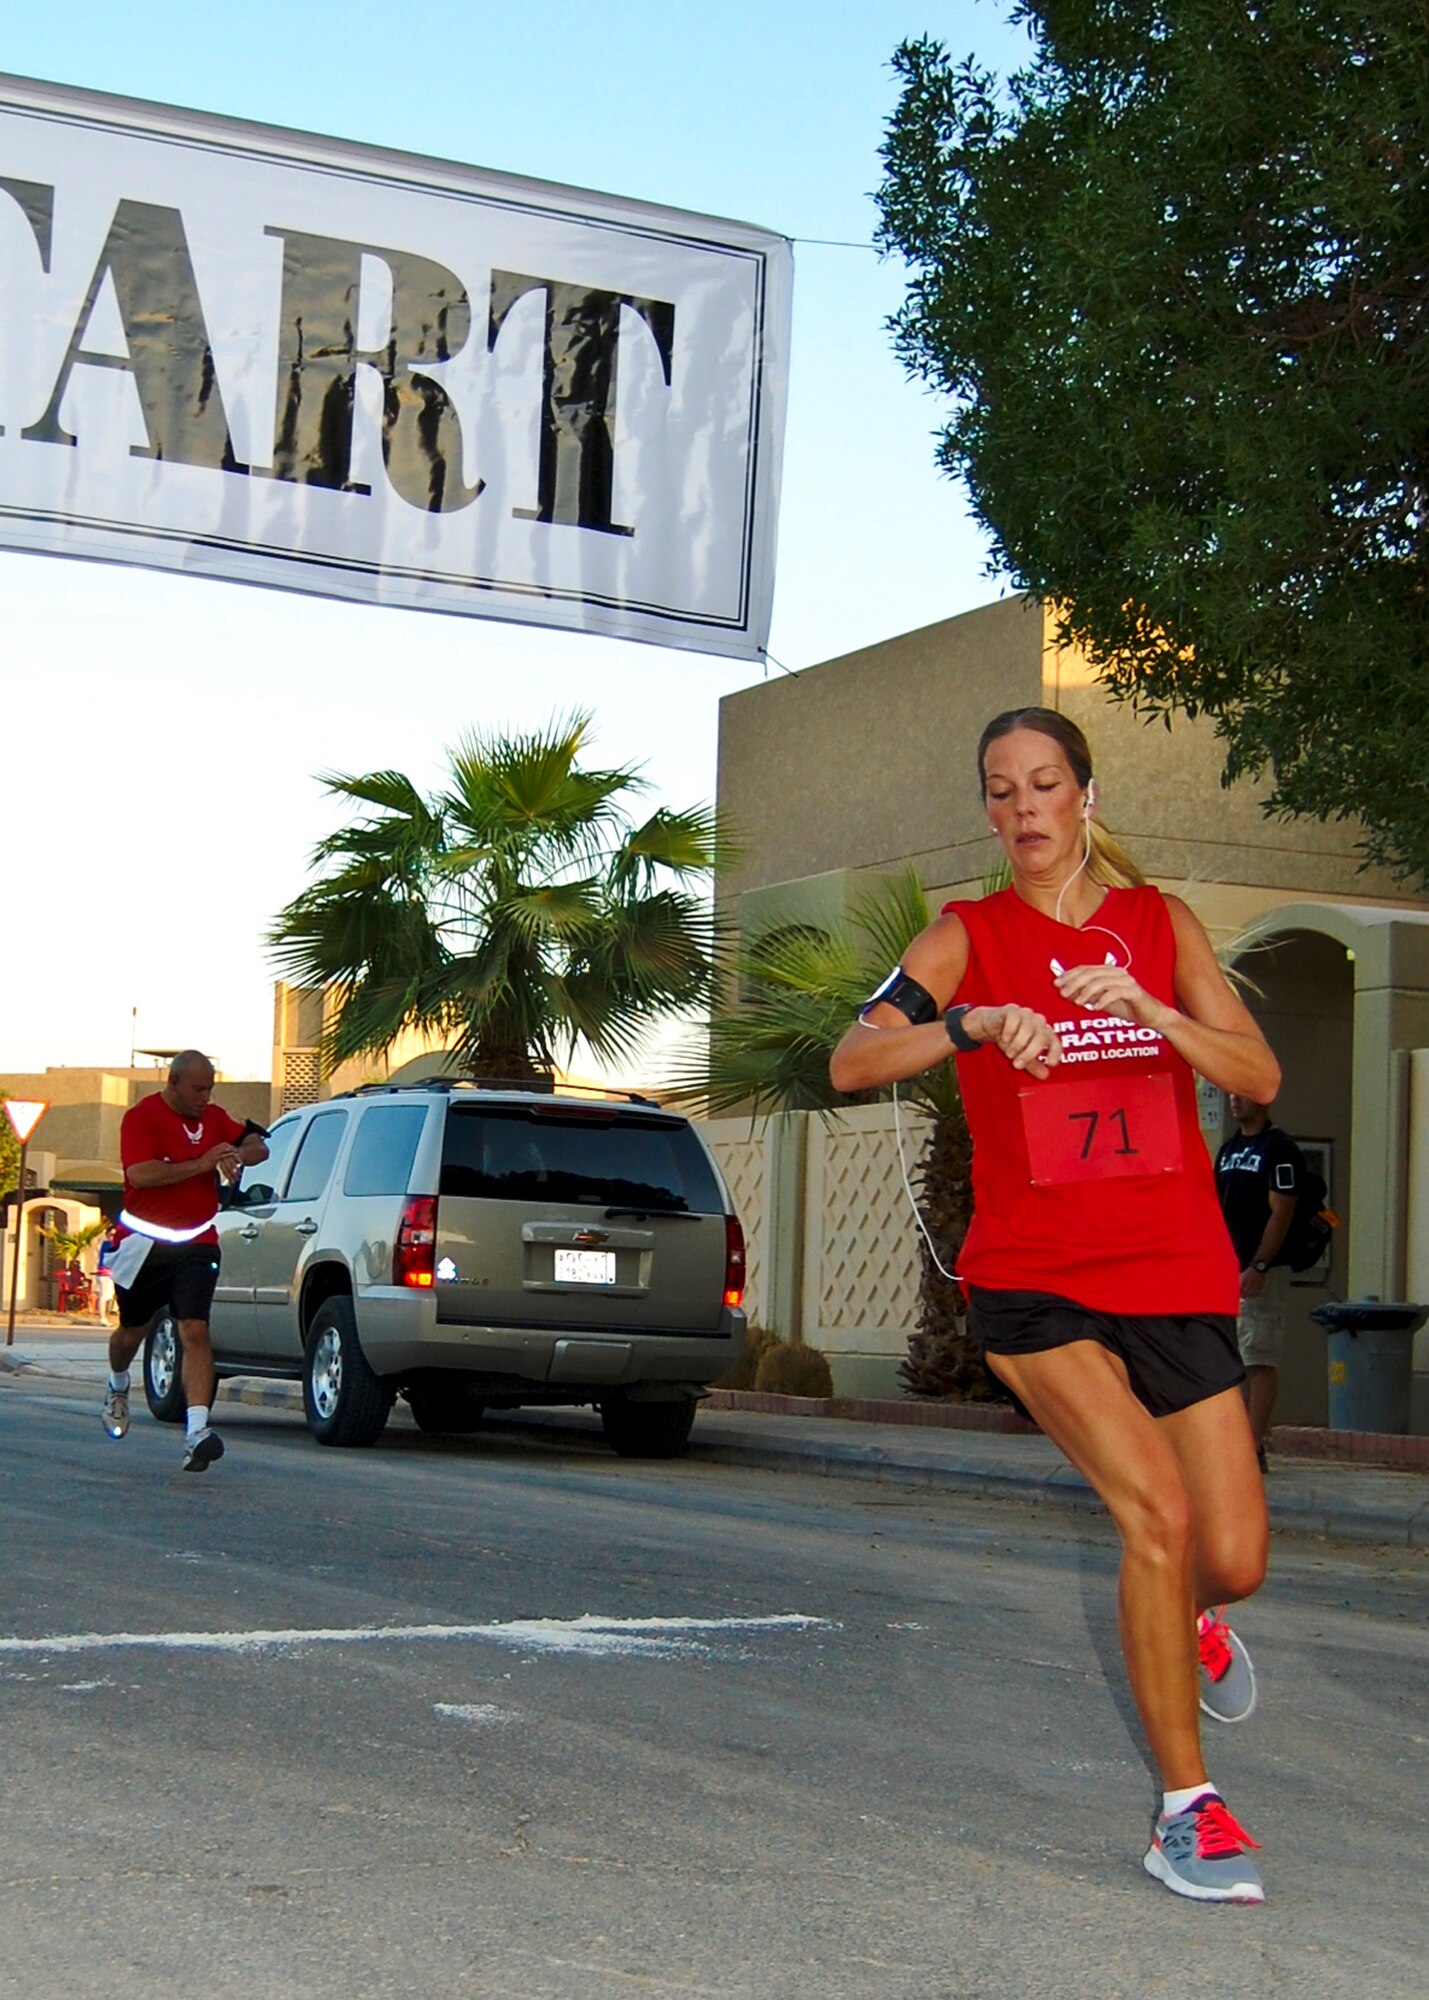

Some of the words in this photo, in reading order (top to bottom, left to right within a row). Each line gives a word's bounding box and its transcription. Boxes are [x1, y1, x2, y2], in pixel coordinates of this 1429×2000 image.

[1054, 1020, 1075, 1034] IR
[1062, 1029, 1162, 1048] RATHO
[1038, 1050, 1099, 1064] LOYED
[1101, 1046, 1159, 1060] LOCATION
[1068, 1107, 1140, 1160] 71
